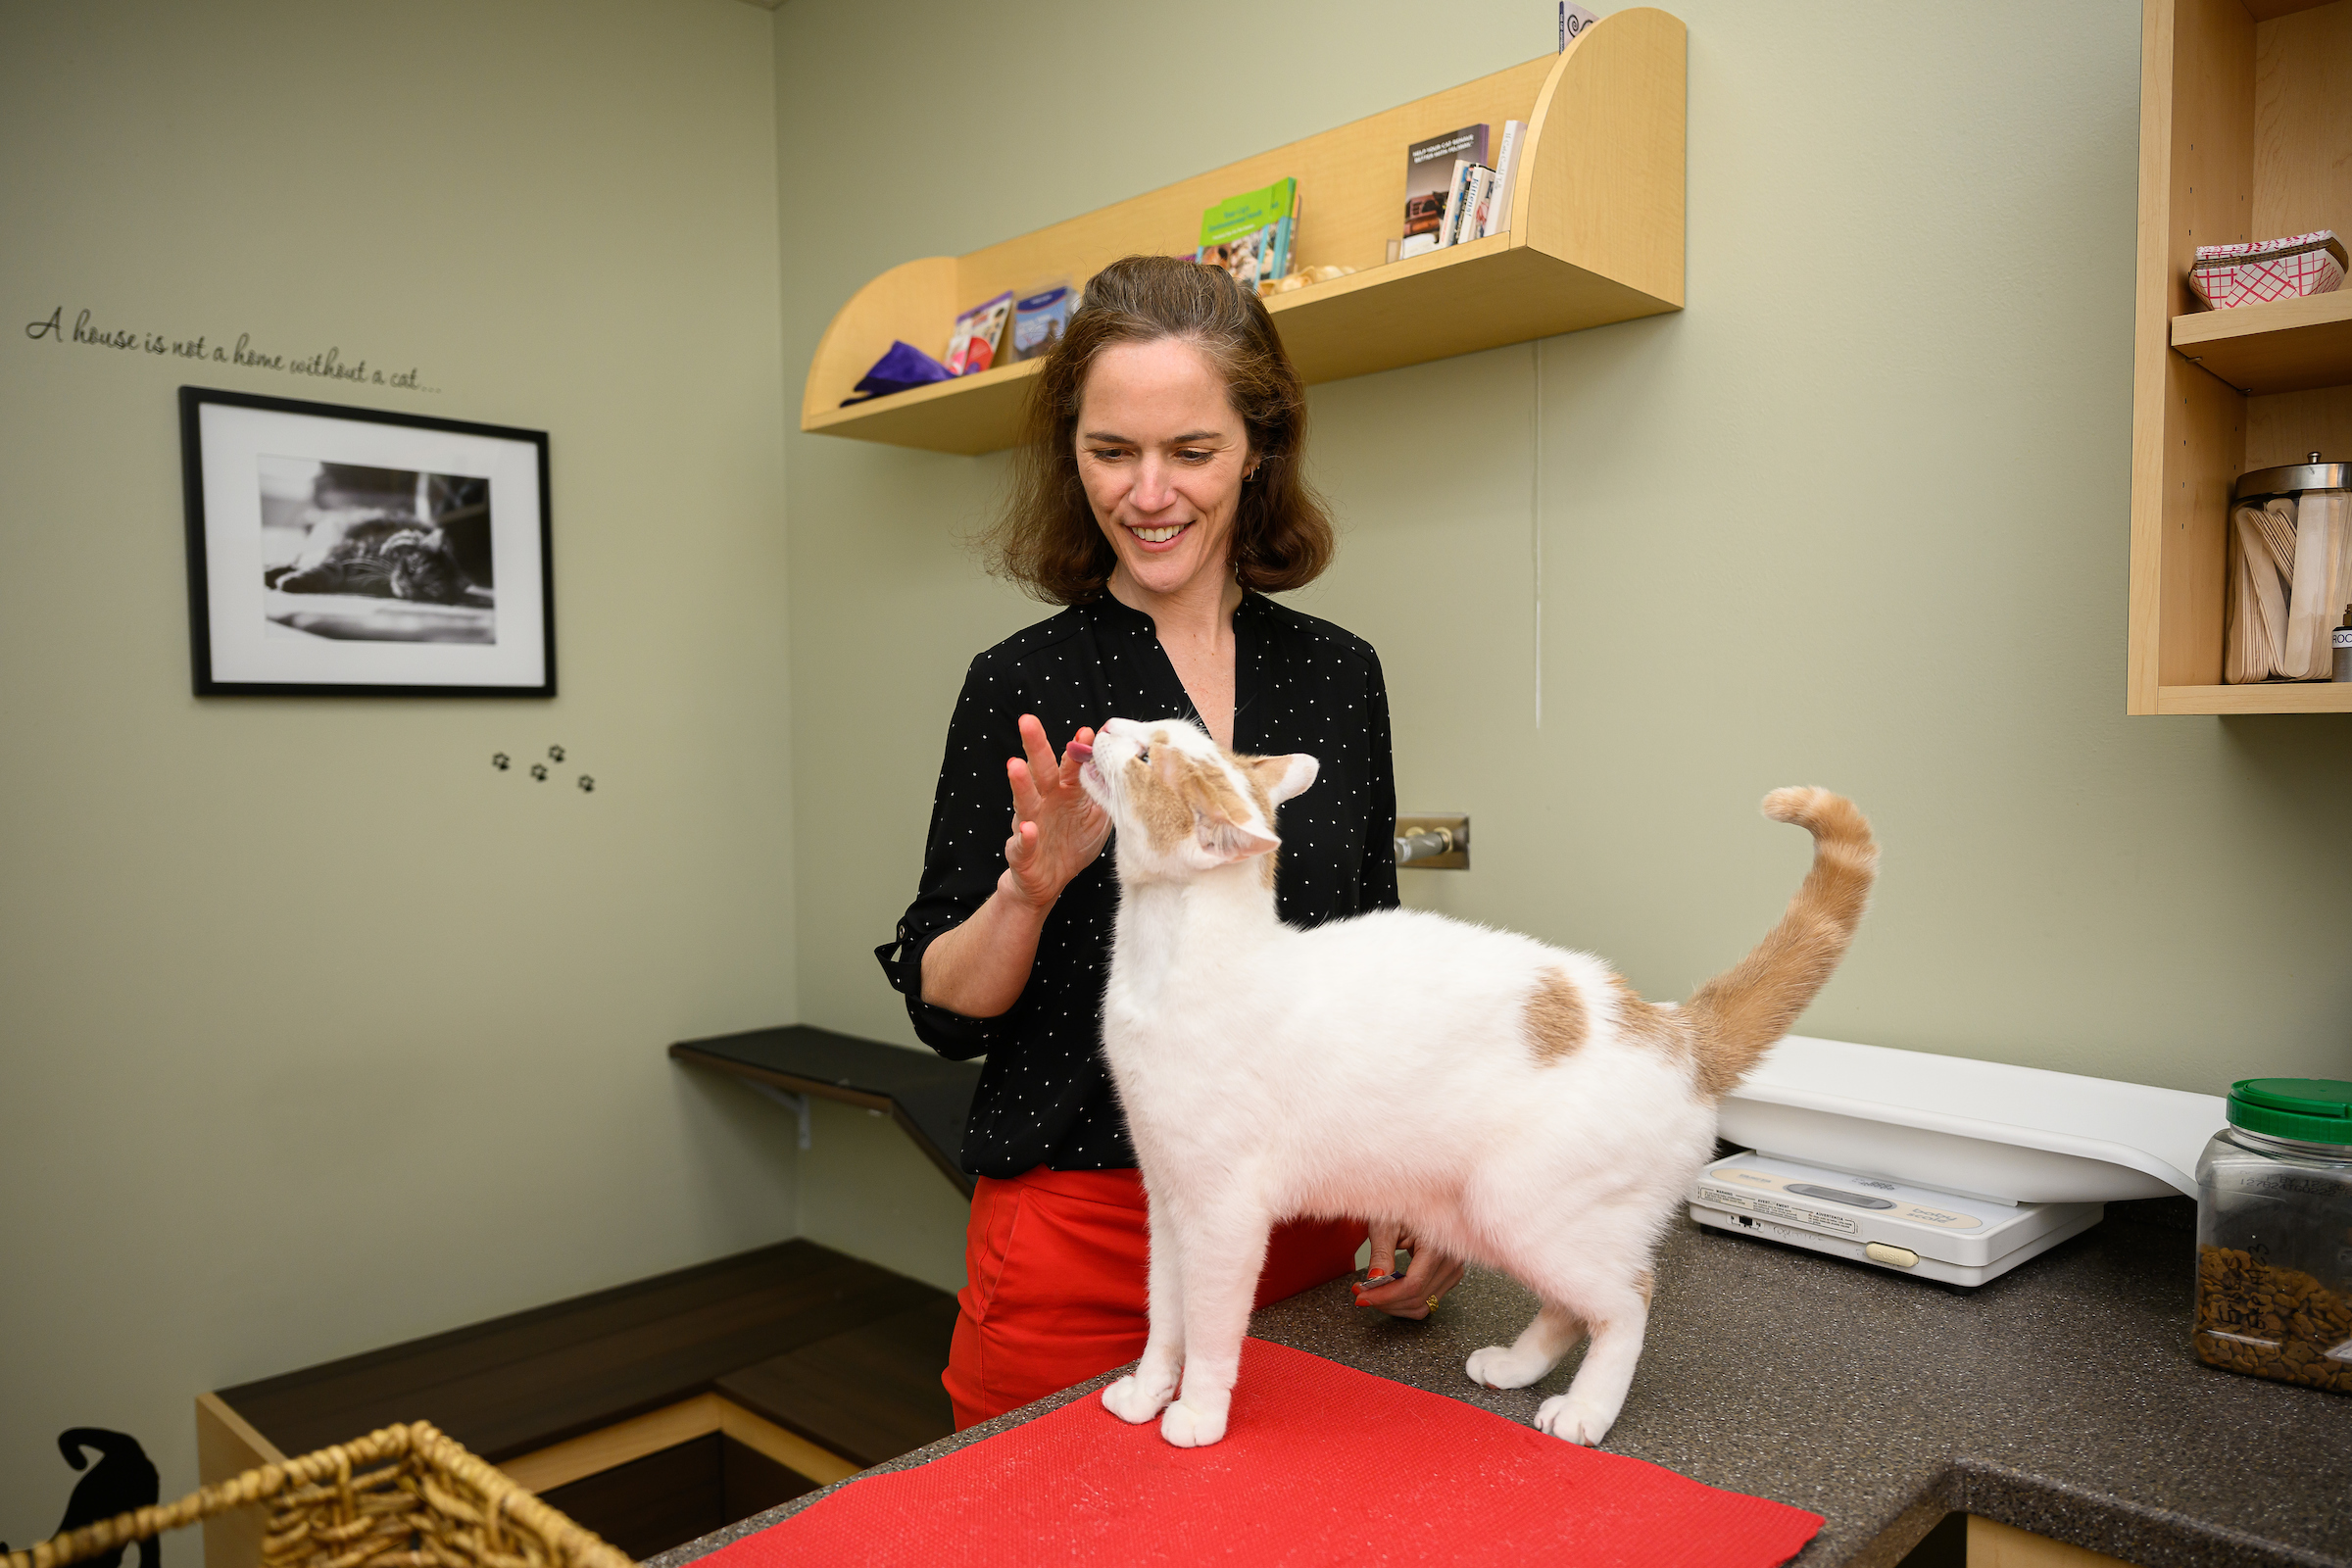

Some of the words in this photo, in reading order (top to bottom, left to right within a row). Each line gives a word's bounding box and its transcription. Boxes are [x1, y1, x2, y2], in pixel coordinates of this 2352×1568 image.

[1465, 176, 1479, 218] Kittens!
[25, 306, 64, 343] A
[73, 309, 139, 350] house
[144, 331, 168, 355] is
[172, 335, 210, 361] not
[213, 345, 229, 363] a
[233, 332, 284, 371] home
[290, 346, 368, 383] without
[371, 368, 386, 386] a
[1906, 1212, 1949, 1225] scale
[1912, 1207, 1958, 1223] baby
[1875, 1250, 1901, 1263] PUSH
